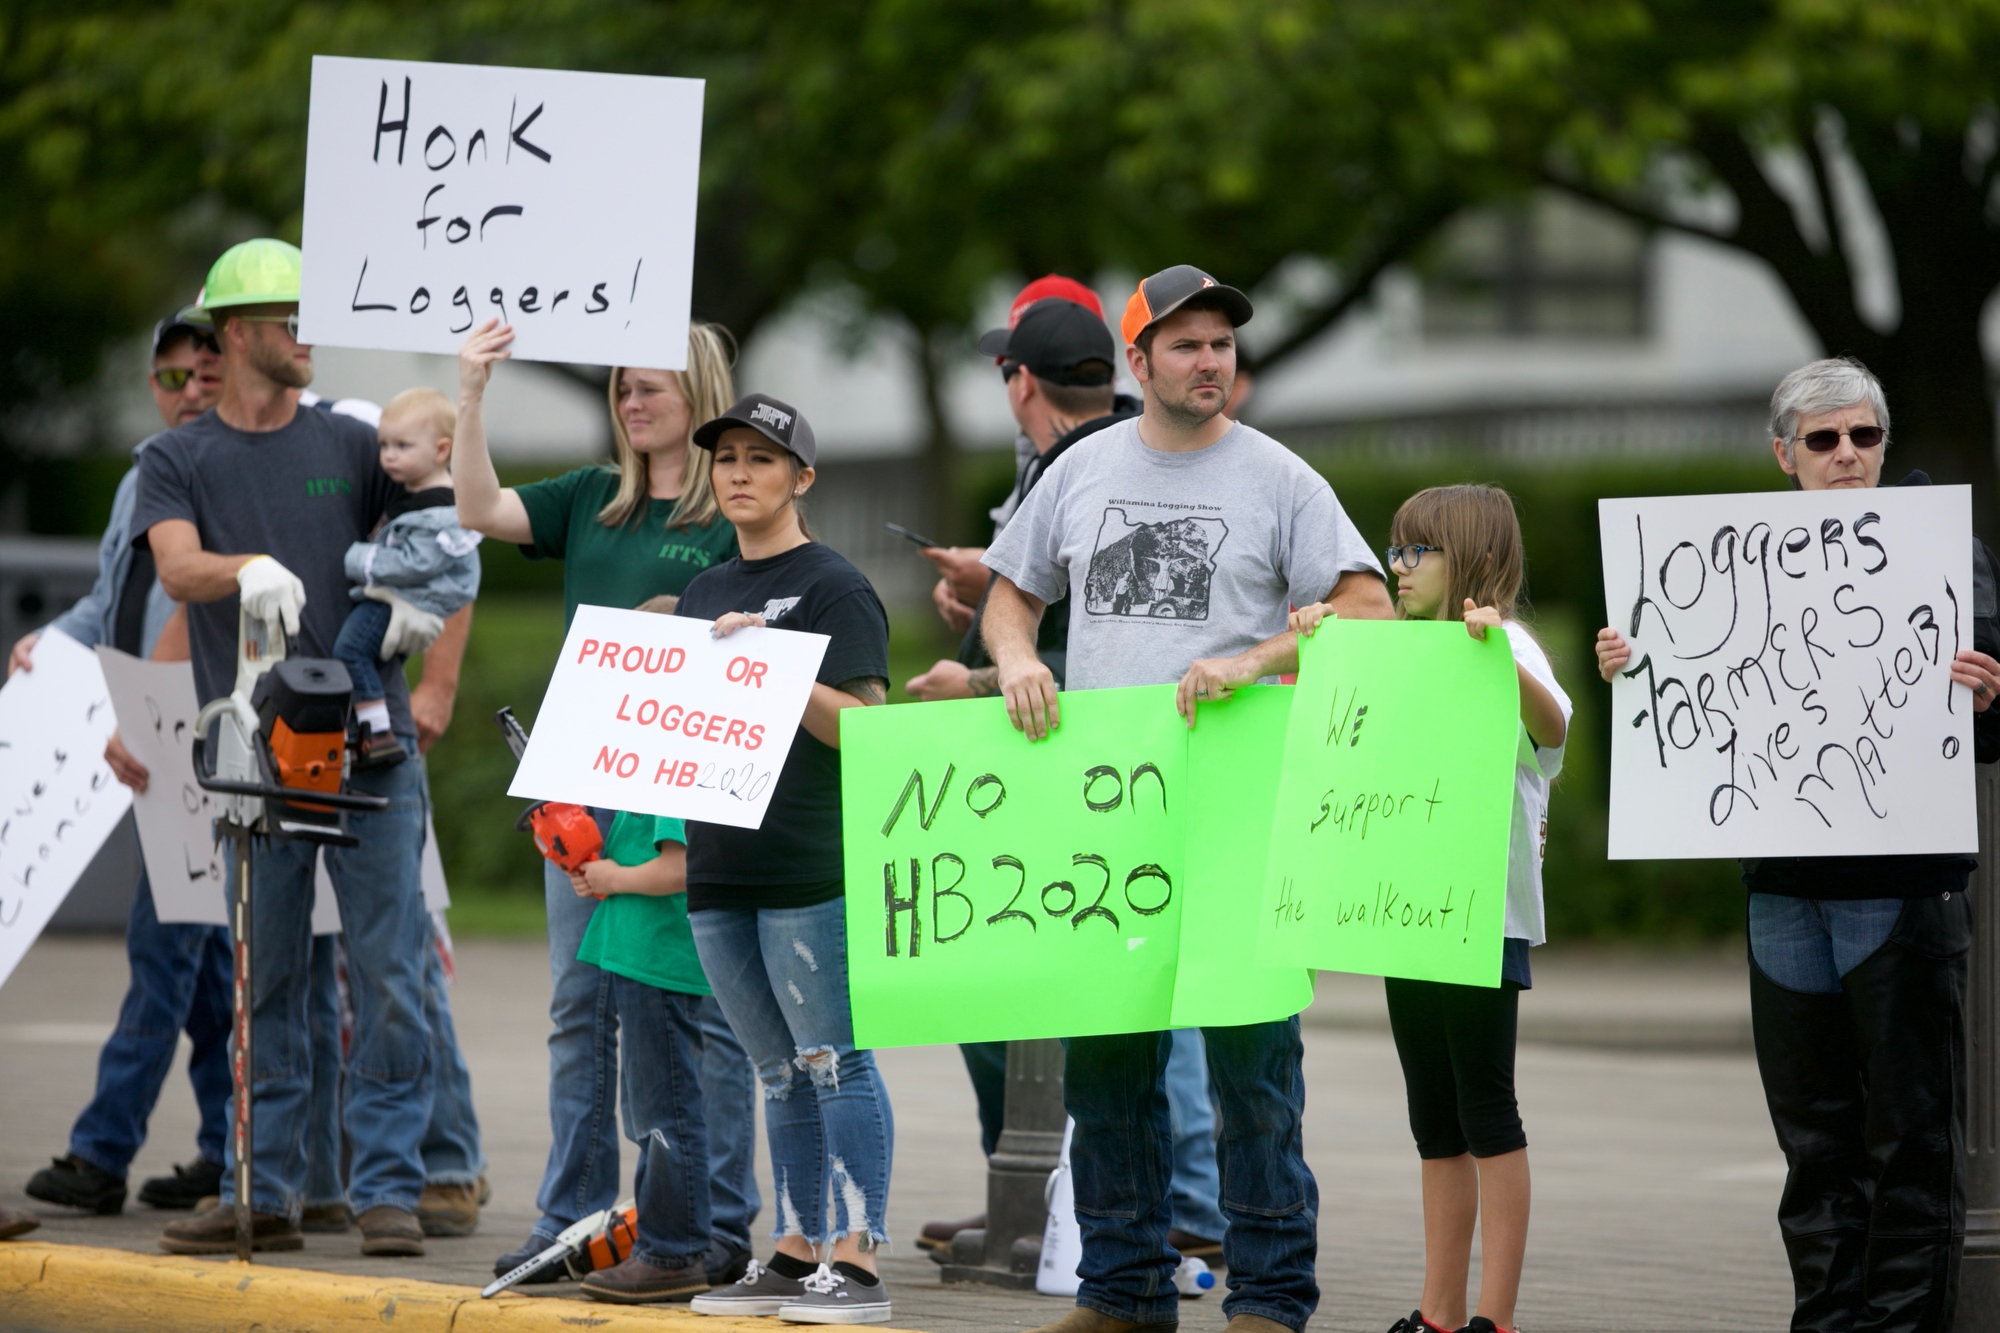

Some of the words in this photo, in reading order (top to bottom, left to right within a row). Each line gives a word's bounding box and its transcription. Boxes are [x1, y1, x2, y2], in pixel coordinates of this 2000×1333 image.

[416, 183, 524, 250] for
[351, 255, 643, 334] Loggers!
[1108, 498, 1156, 508] Willamina
[1157, 501, 1196, 511] Logging
[577, 639, 686, 674] PROUD
[726, 656, 768, 688] OR
[616, 694, 765, 750] LOGGERS
[593, 745, 639, 778] NO
[881, 763, 1006, 838] No
[1084, 762, 1168, 815] on
[1311, 778, 1443, 840] support
[884, 852, 1172, 958] HB2020
[1275, 876, 1305, 929] the
[1337, 881, 1476, 944] walkout!
